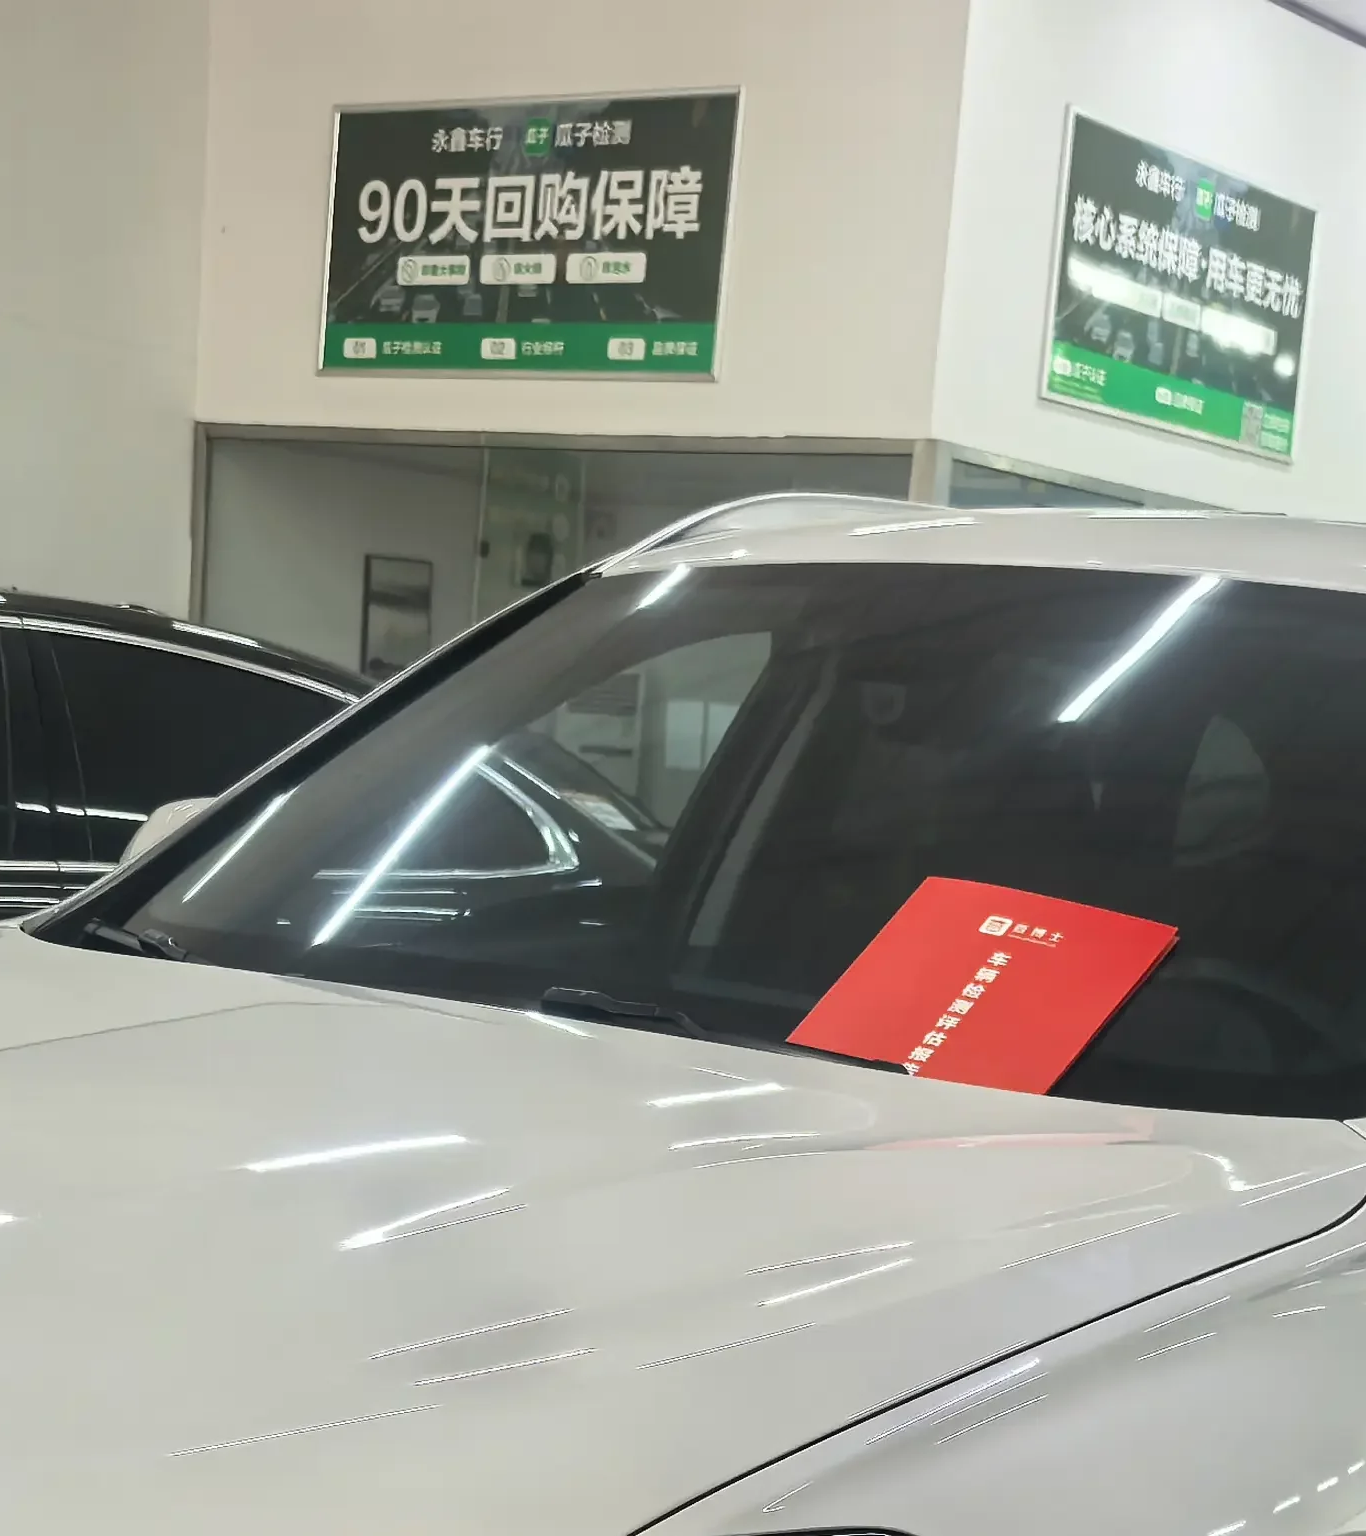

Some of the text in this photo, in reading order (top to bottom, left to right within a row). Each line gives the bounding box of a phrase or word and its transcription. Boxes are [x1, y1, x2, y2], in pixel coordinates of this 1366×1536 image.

[357, 165, 704, 244] 90天回购保障
